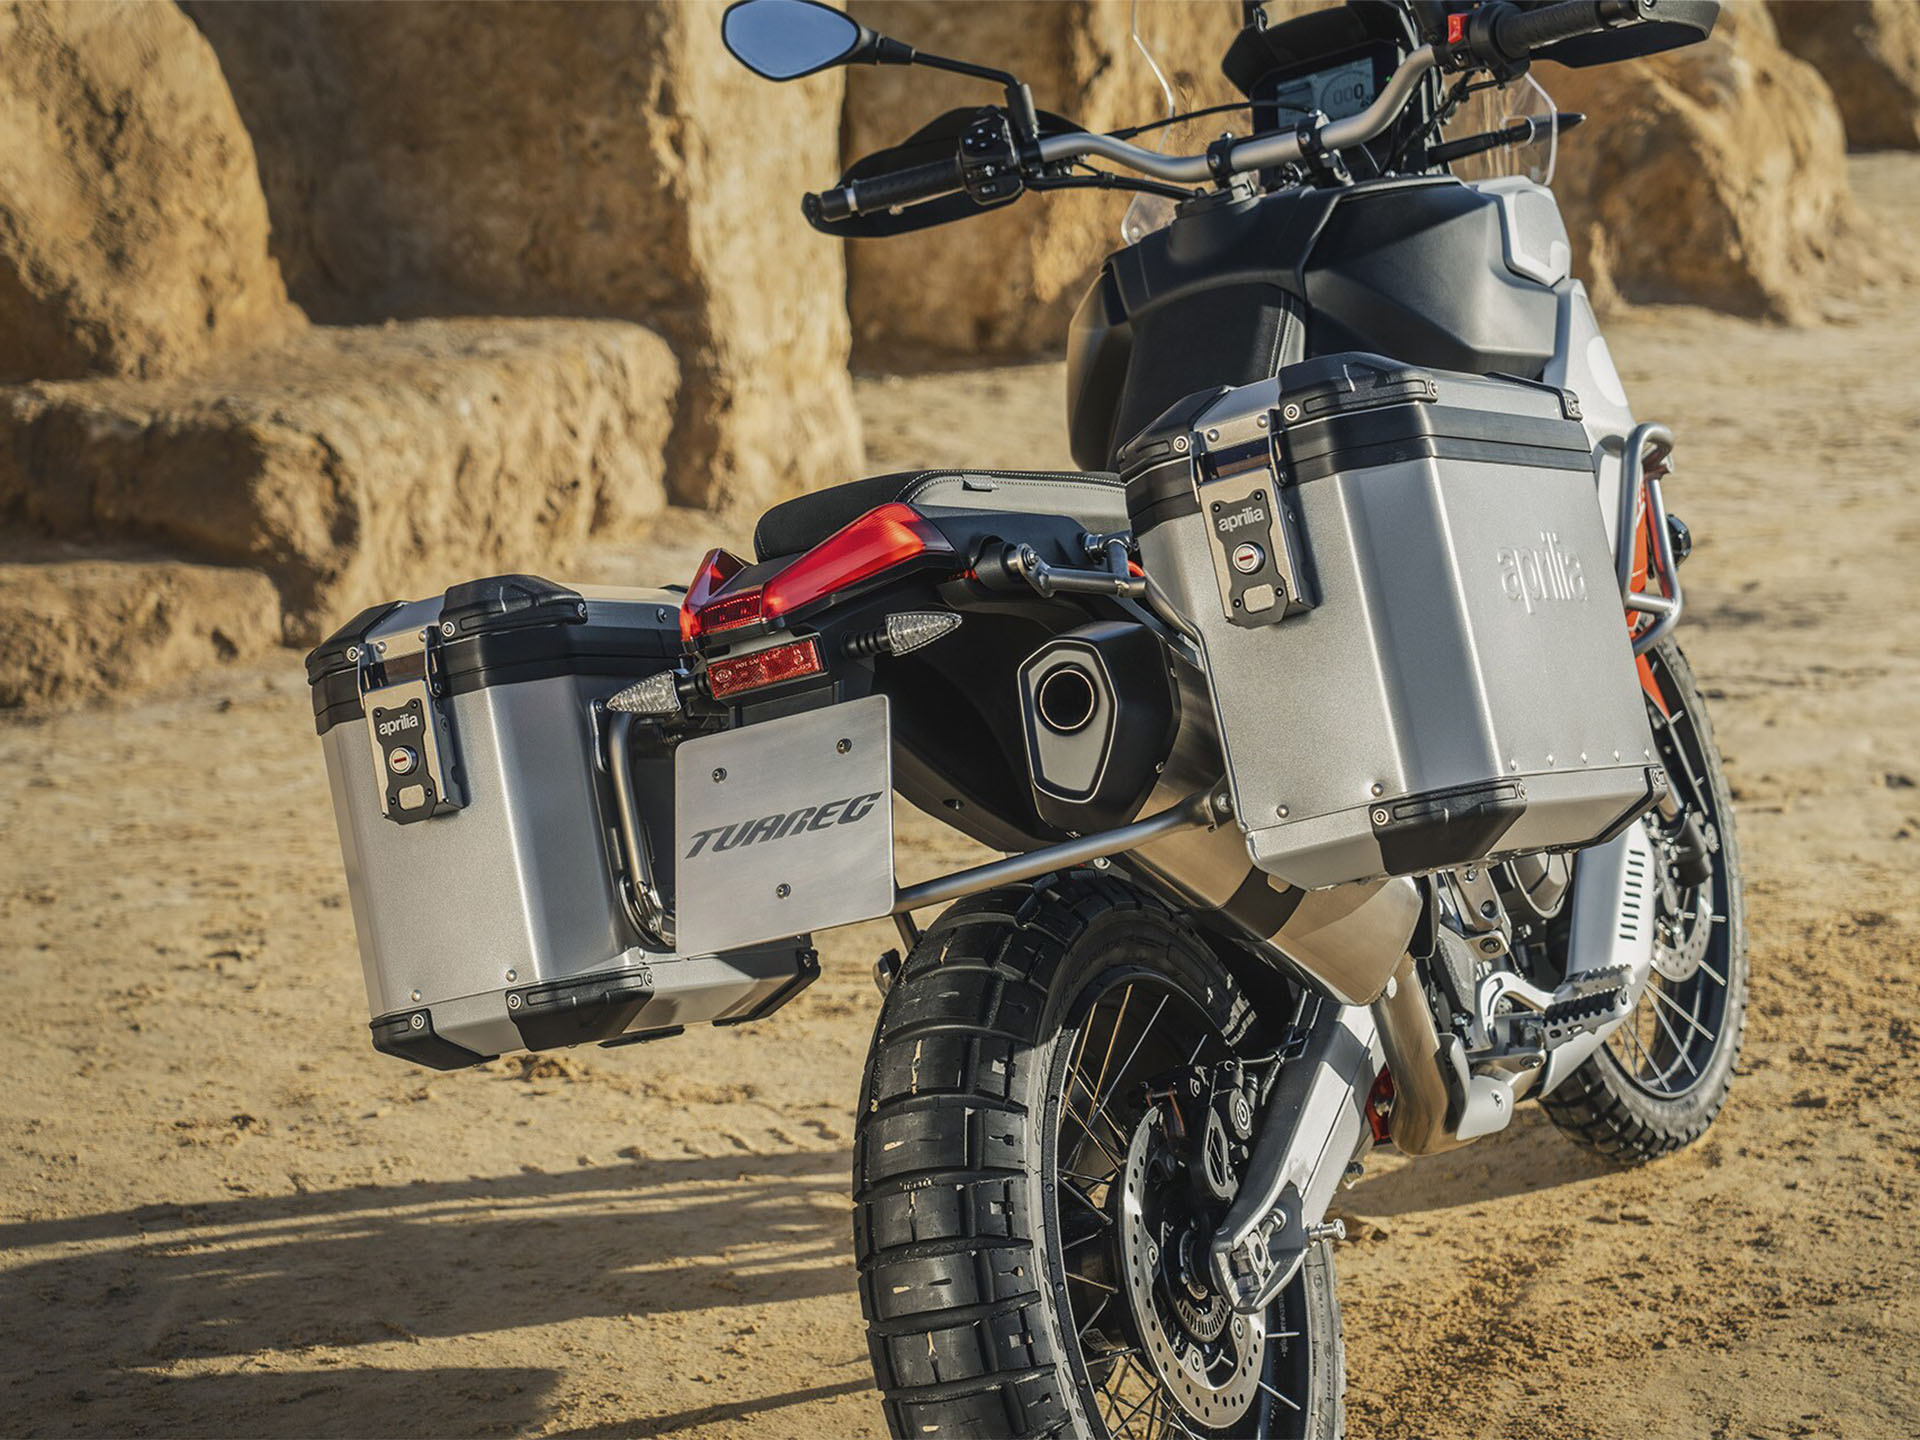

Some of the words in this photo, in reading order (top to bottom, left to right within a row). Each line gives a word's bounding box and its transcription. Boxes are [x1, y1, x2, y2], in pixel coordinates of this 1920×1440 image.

[1218, 506, 1265, 532] aprilia
[1497, 530, 1588, 614] aprilia
[379, 713, 419, 736] aprilia
[685, 791, 884, 859] TUAREG
